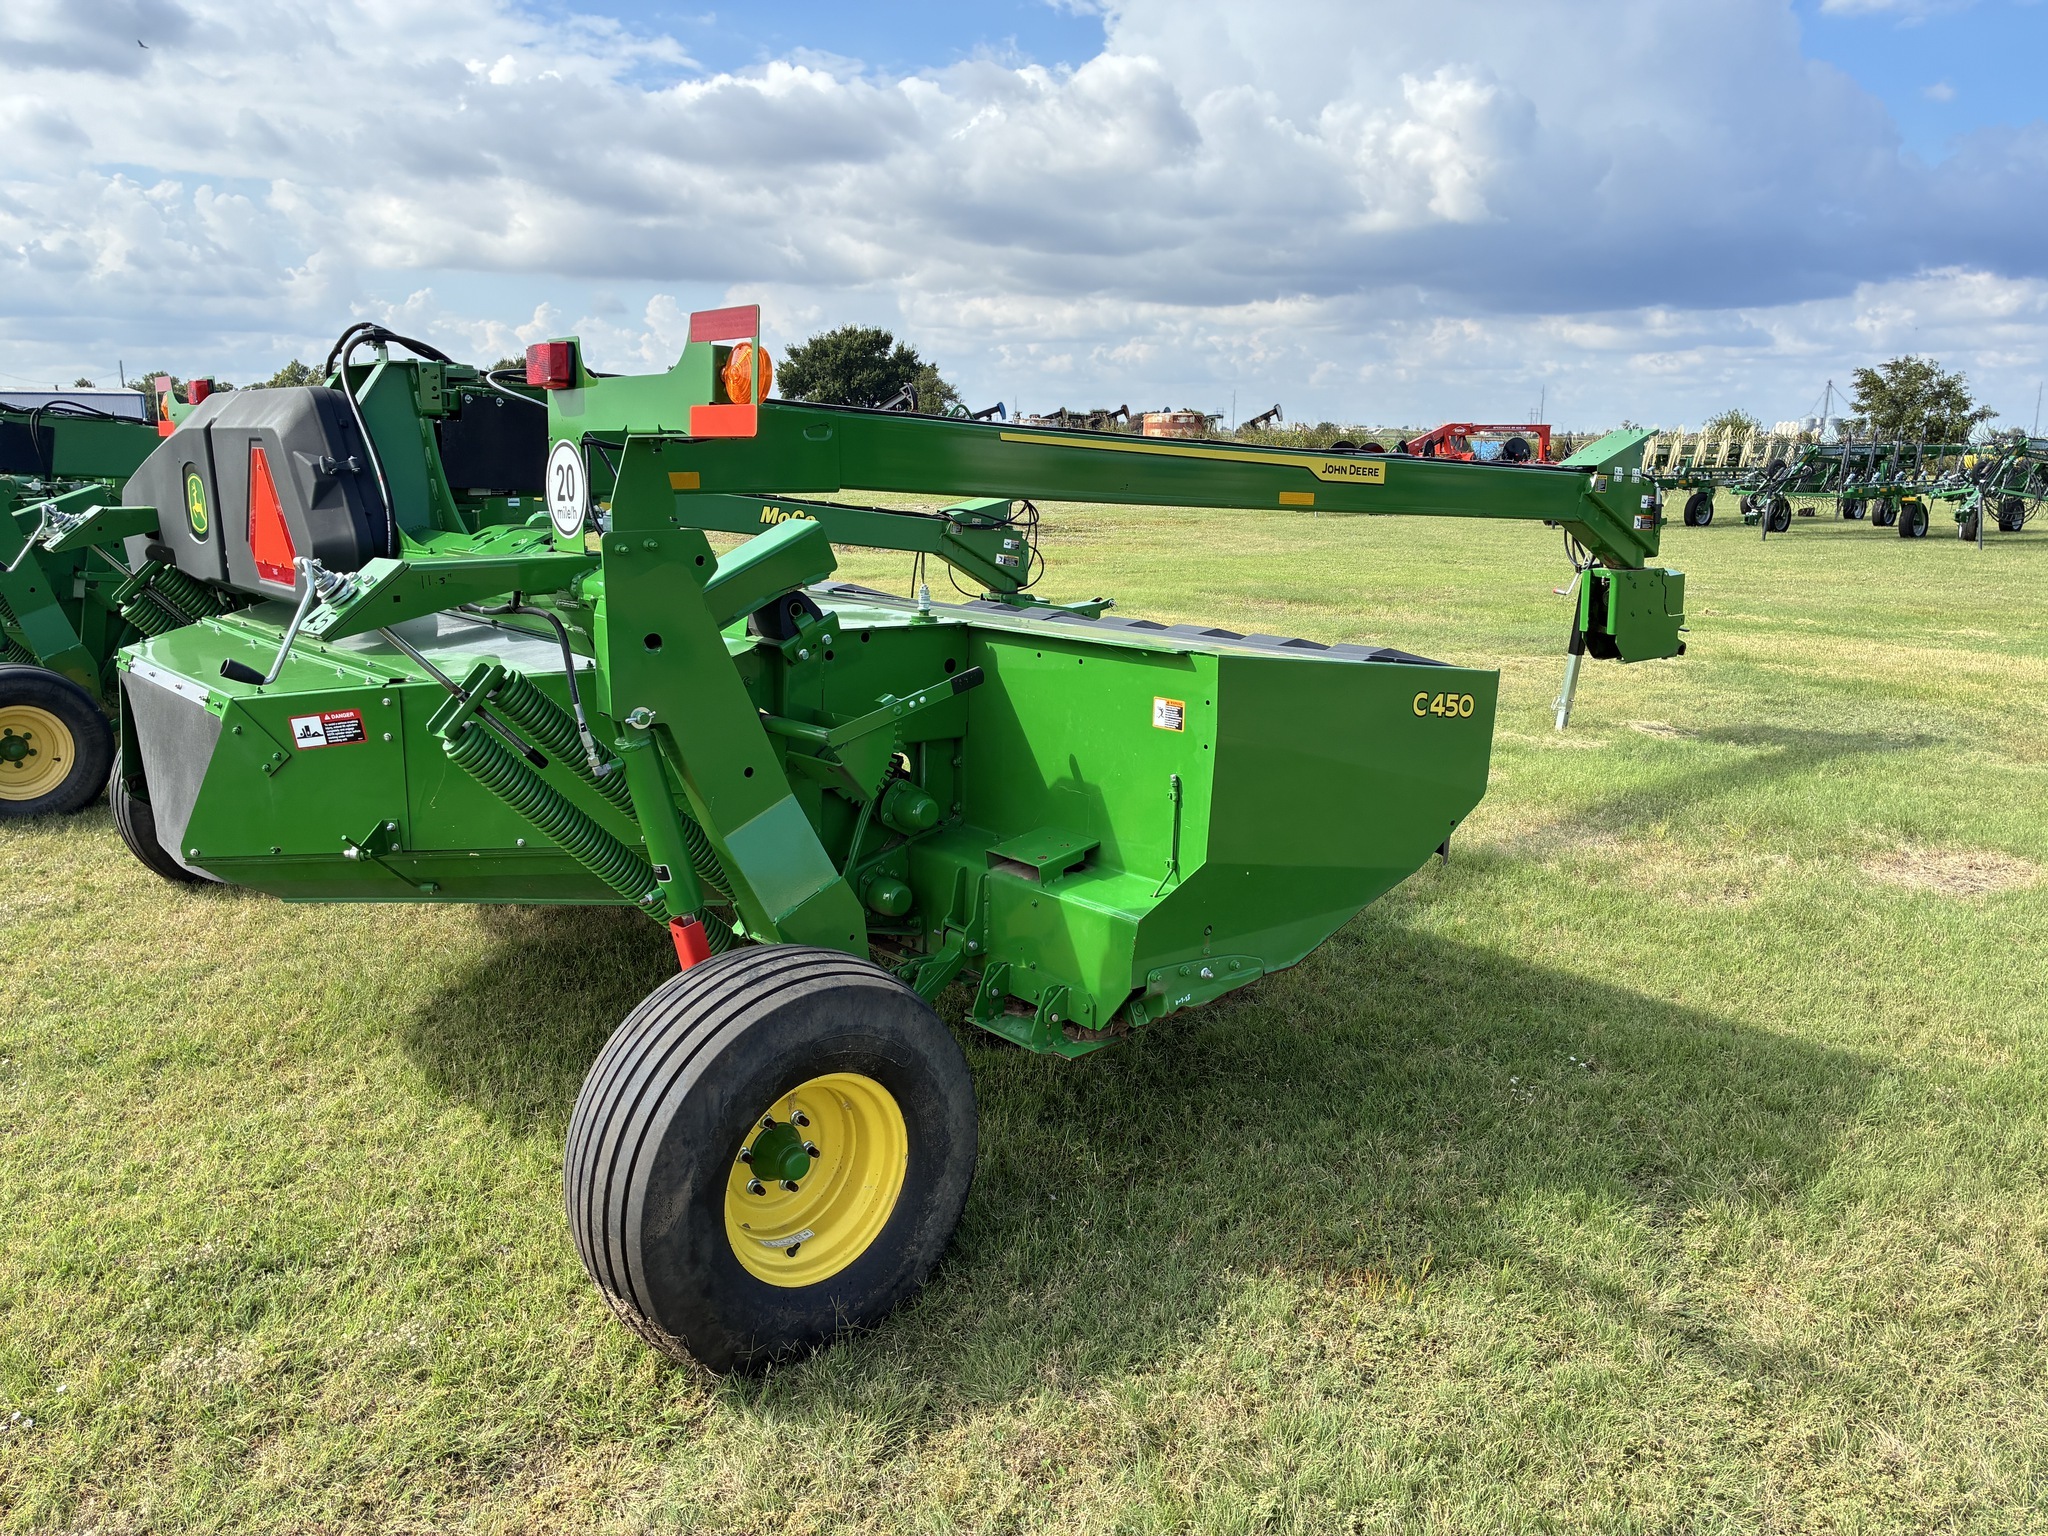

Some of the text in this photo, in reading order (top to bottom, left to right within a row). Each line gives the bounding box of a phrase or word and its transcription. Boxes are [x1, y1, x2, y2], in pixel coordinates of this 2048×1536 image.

[1322, 463, 1380, 477] JOHN DEERE
[556, 464, 575, 502] 20
[557, 506, 578, 520] mile/h
[1412, 691, 1475, 718] C450
[330, 711, 355, 720] DANGER
